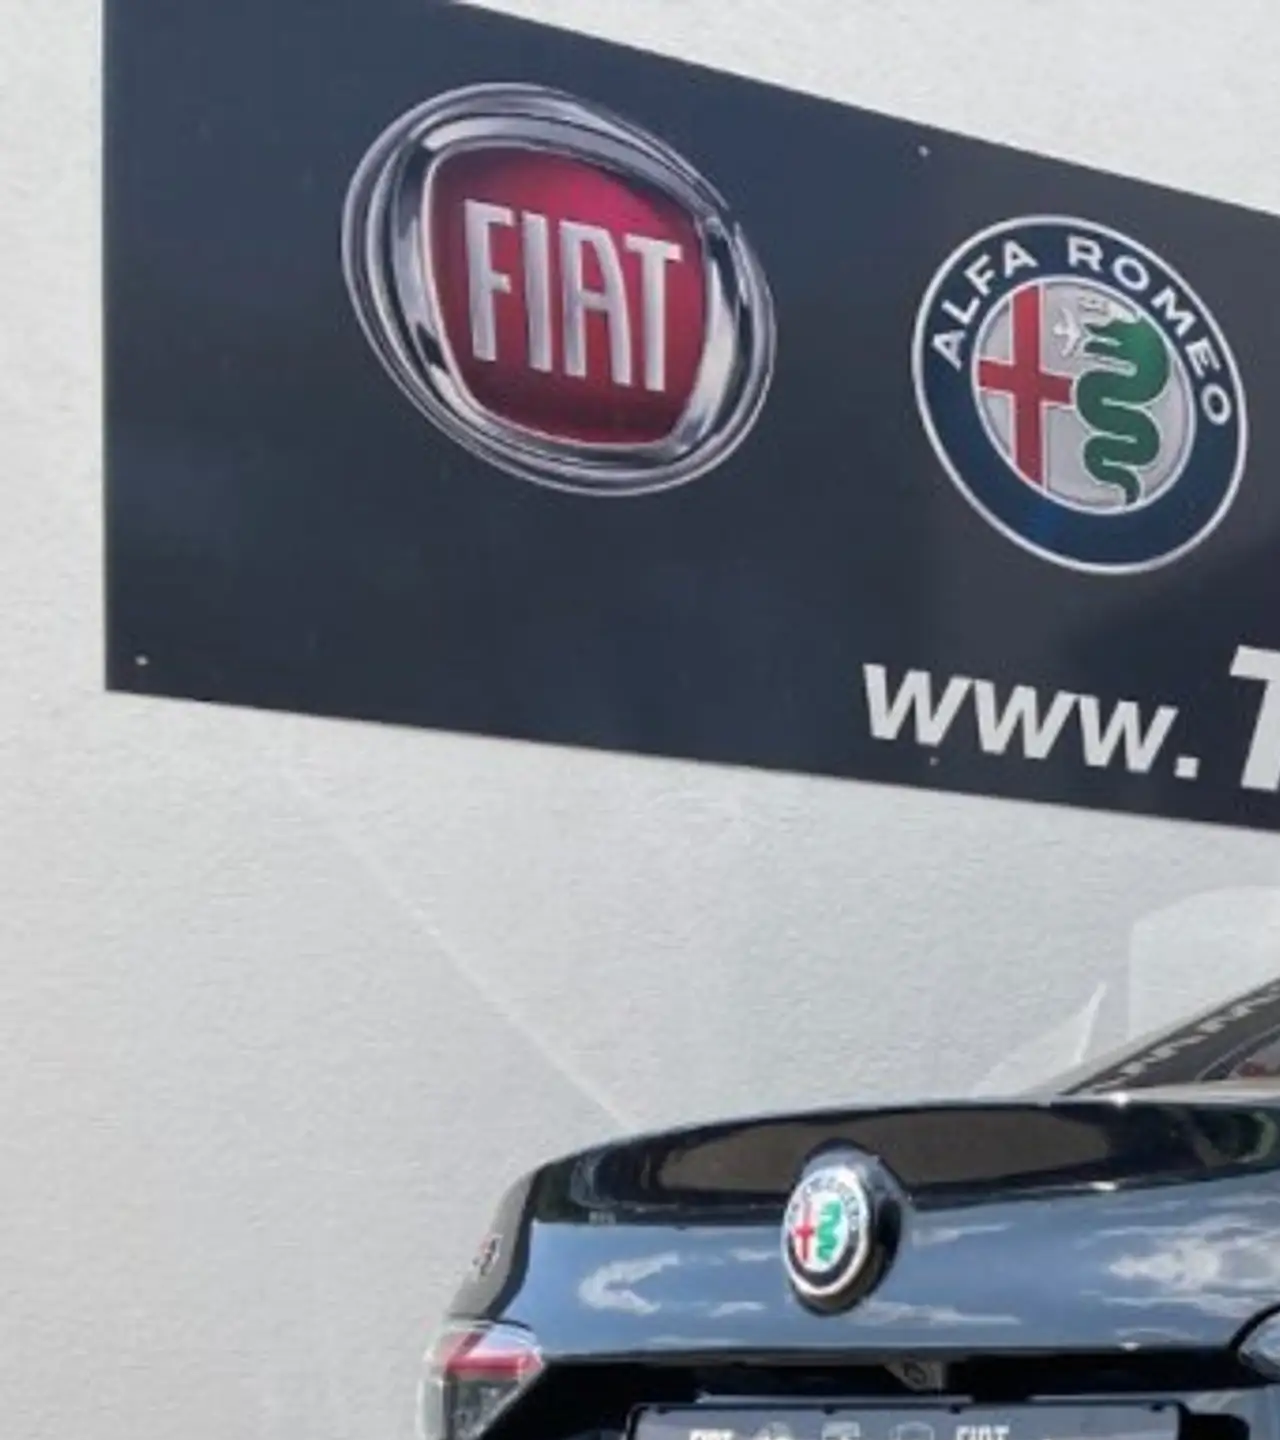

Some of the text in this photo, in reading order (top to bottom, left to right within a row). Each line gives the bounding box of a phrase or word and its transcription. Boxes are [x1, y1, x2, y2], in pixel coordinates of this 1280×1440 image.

[464, 199, 682, 392] FIAT
[931, 235, 1232, 425] ALFA ROMEO
